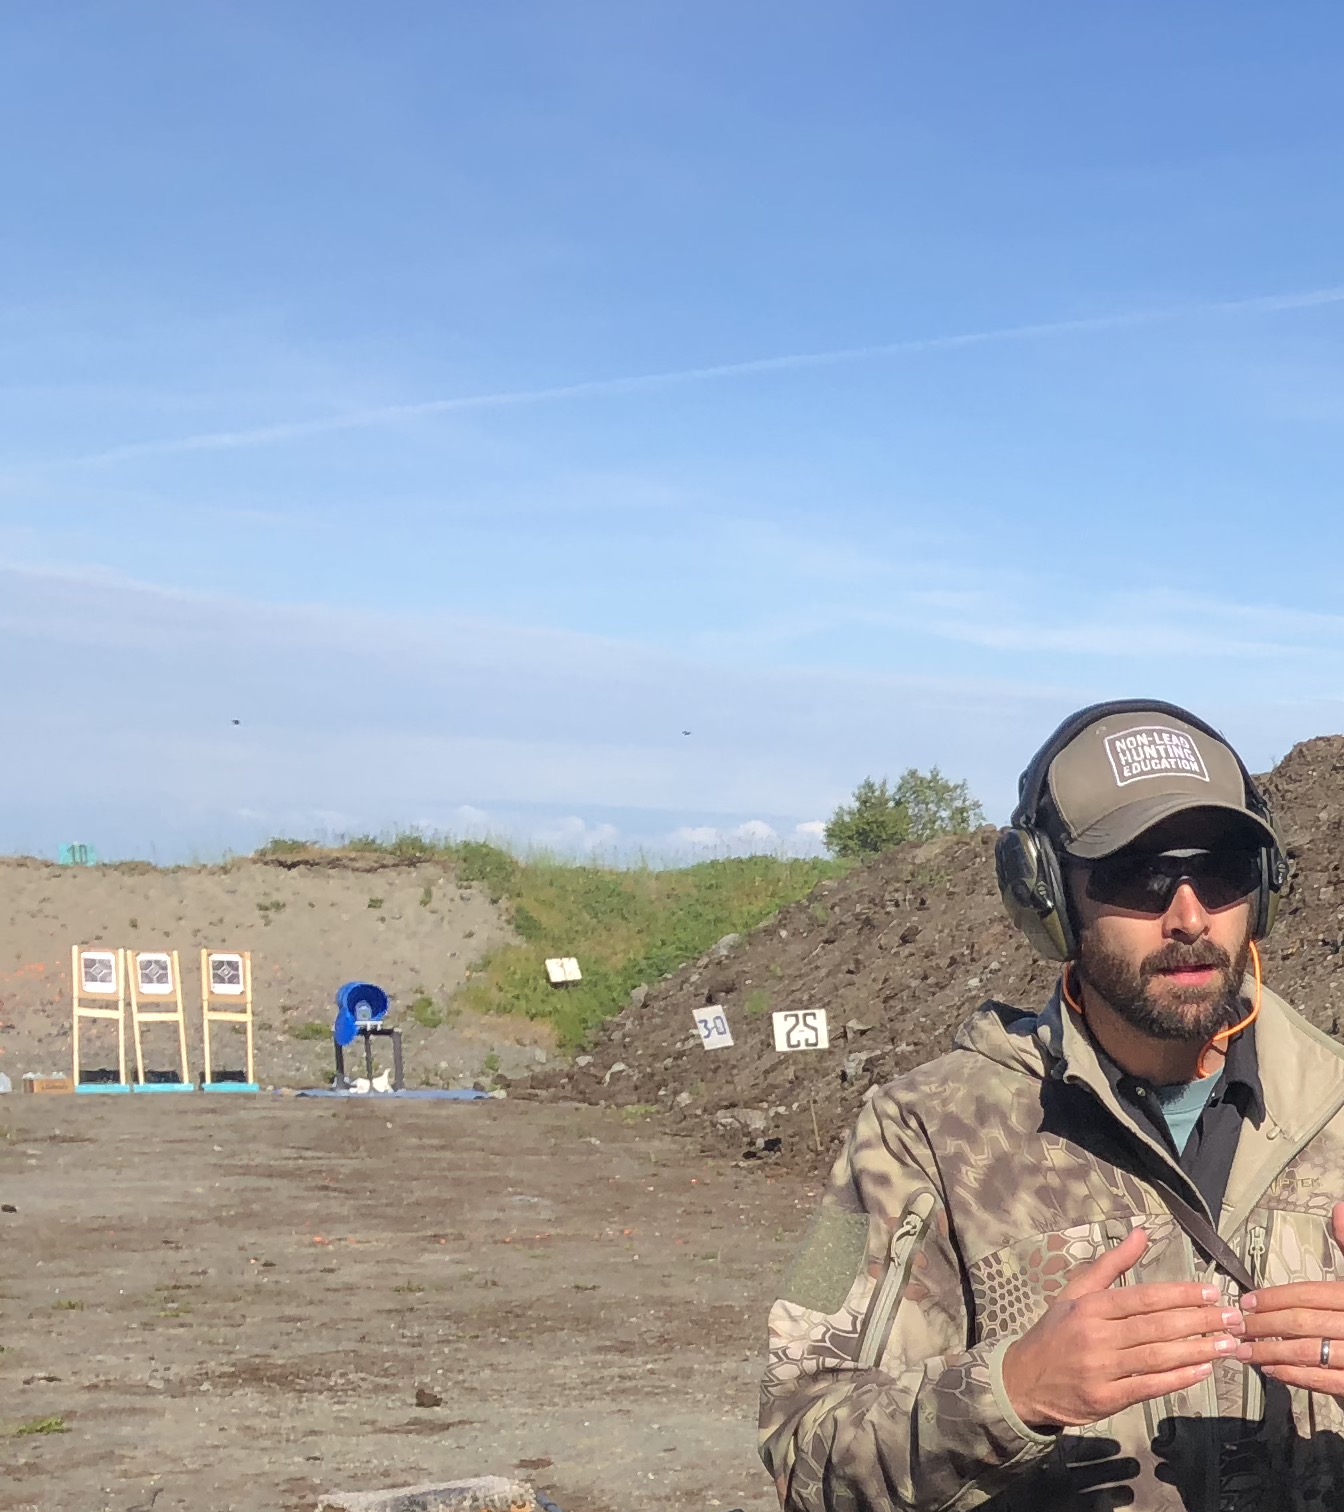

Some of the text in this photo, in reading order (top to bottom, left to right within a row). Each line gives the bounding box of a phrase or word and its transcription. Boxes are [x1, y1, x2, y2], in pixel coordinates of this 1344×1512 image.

[1115, 730, 1190, 753] NON-LEAD
[1118, 744, 1195, 765] HUNTING
[1123, 759, 1201, 777] EDUCATION
[784, 1012, 818, 1048] 25
